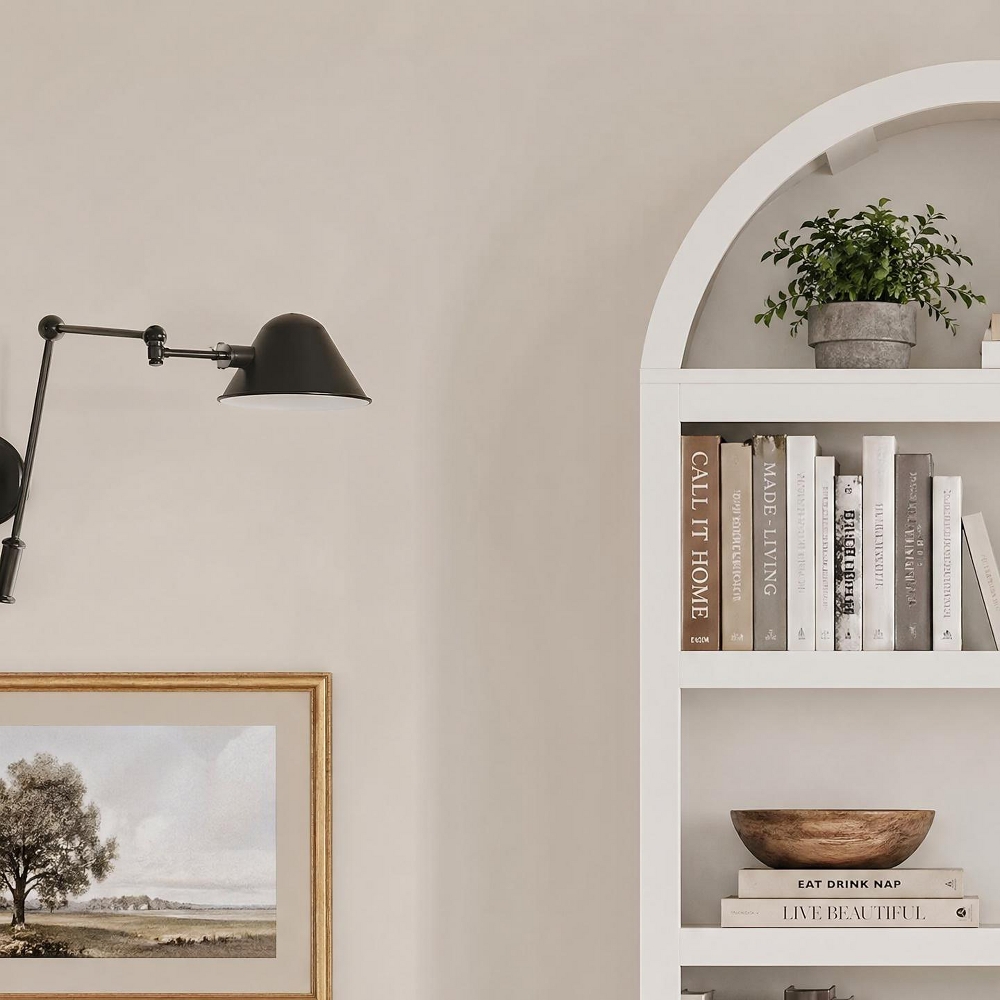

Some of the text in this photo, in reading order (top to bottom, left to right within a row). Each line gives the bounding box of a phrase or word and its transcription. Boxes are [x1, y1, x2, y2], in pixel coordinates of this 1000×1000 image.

[691, 451, 709, 510] CALL
[691, 518, 709, 541] IT
[691, 550, 709, 620] HOME
[798, 880, 902, 889] EAT DRINK NAP
[783, 906, 926, 920] LIVE BEAUTIFUL
